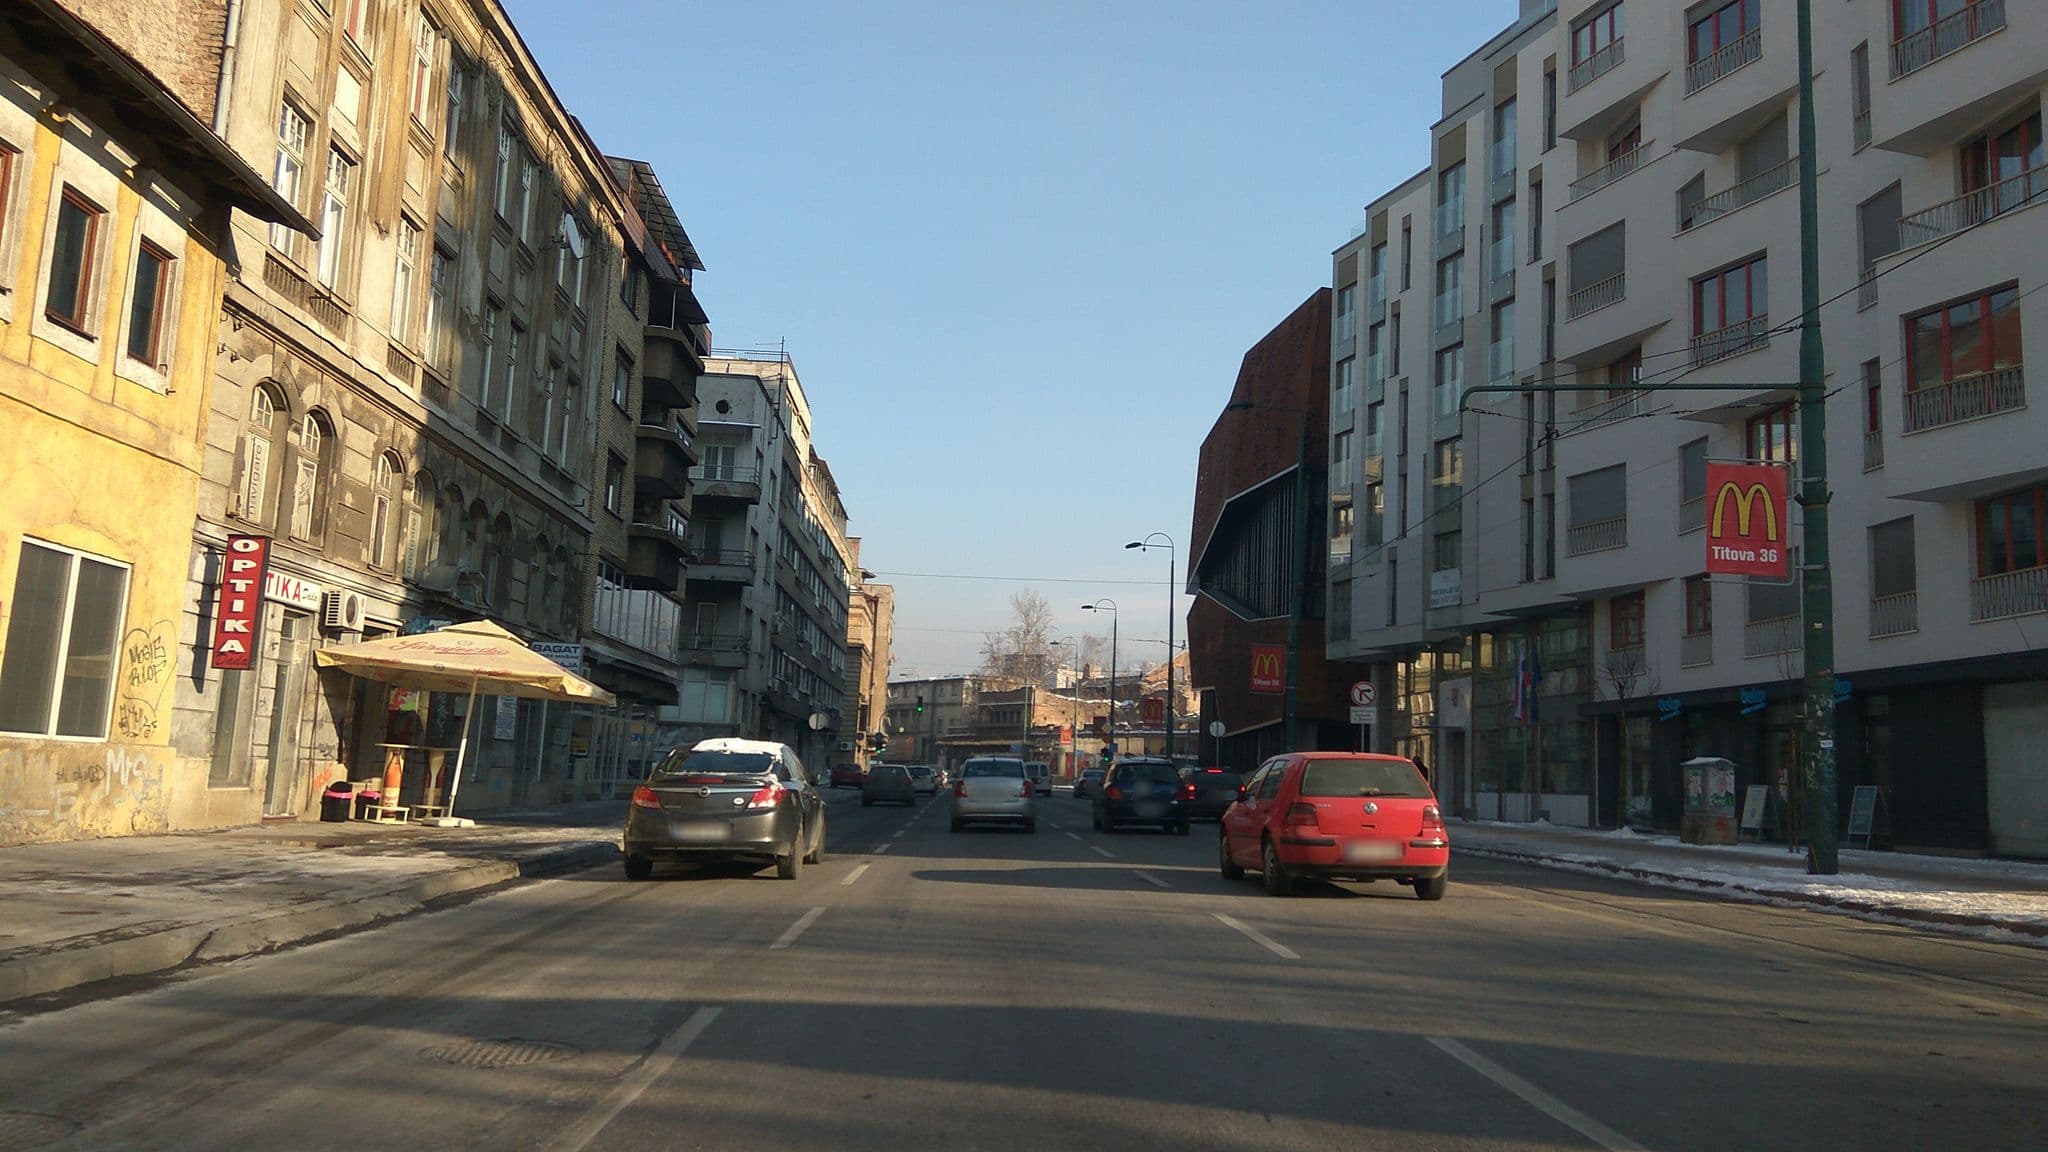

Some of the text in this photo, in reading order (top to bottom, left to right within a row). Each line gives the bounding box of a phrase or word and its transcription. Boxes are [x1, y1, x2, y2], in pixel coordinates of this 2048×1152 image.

[1712, 546, 1777, 563] Titova 36
[218, 539, 260, 653] OPTIKA
[533, 644, 580, 654] BAGAT
